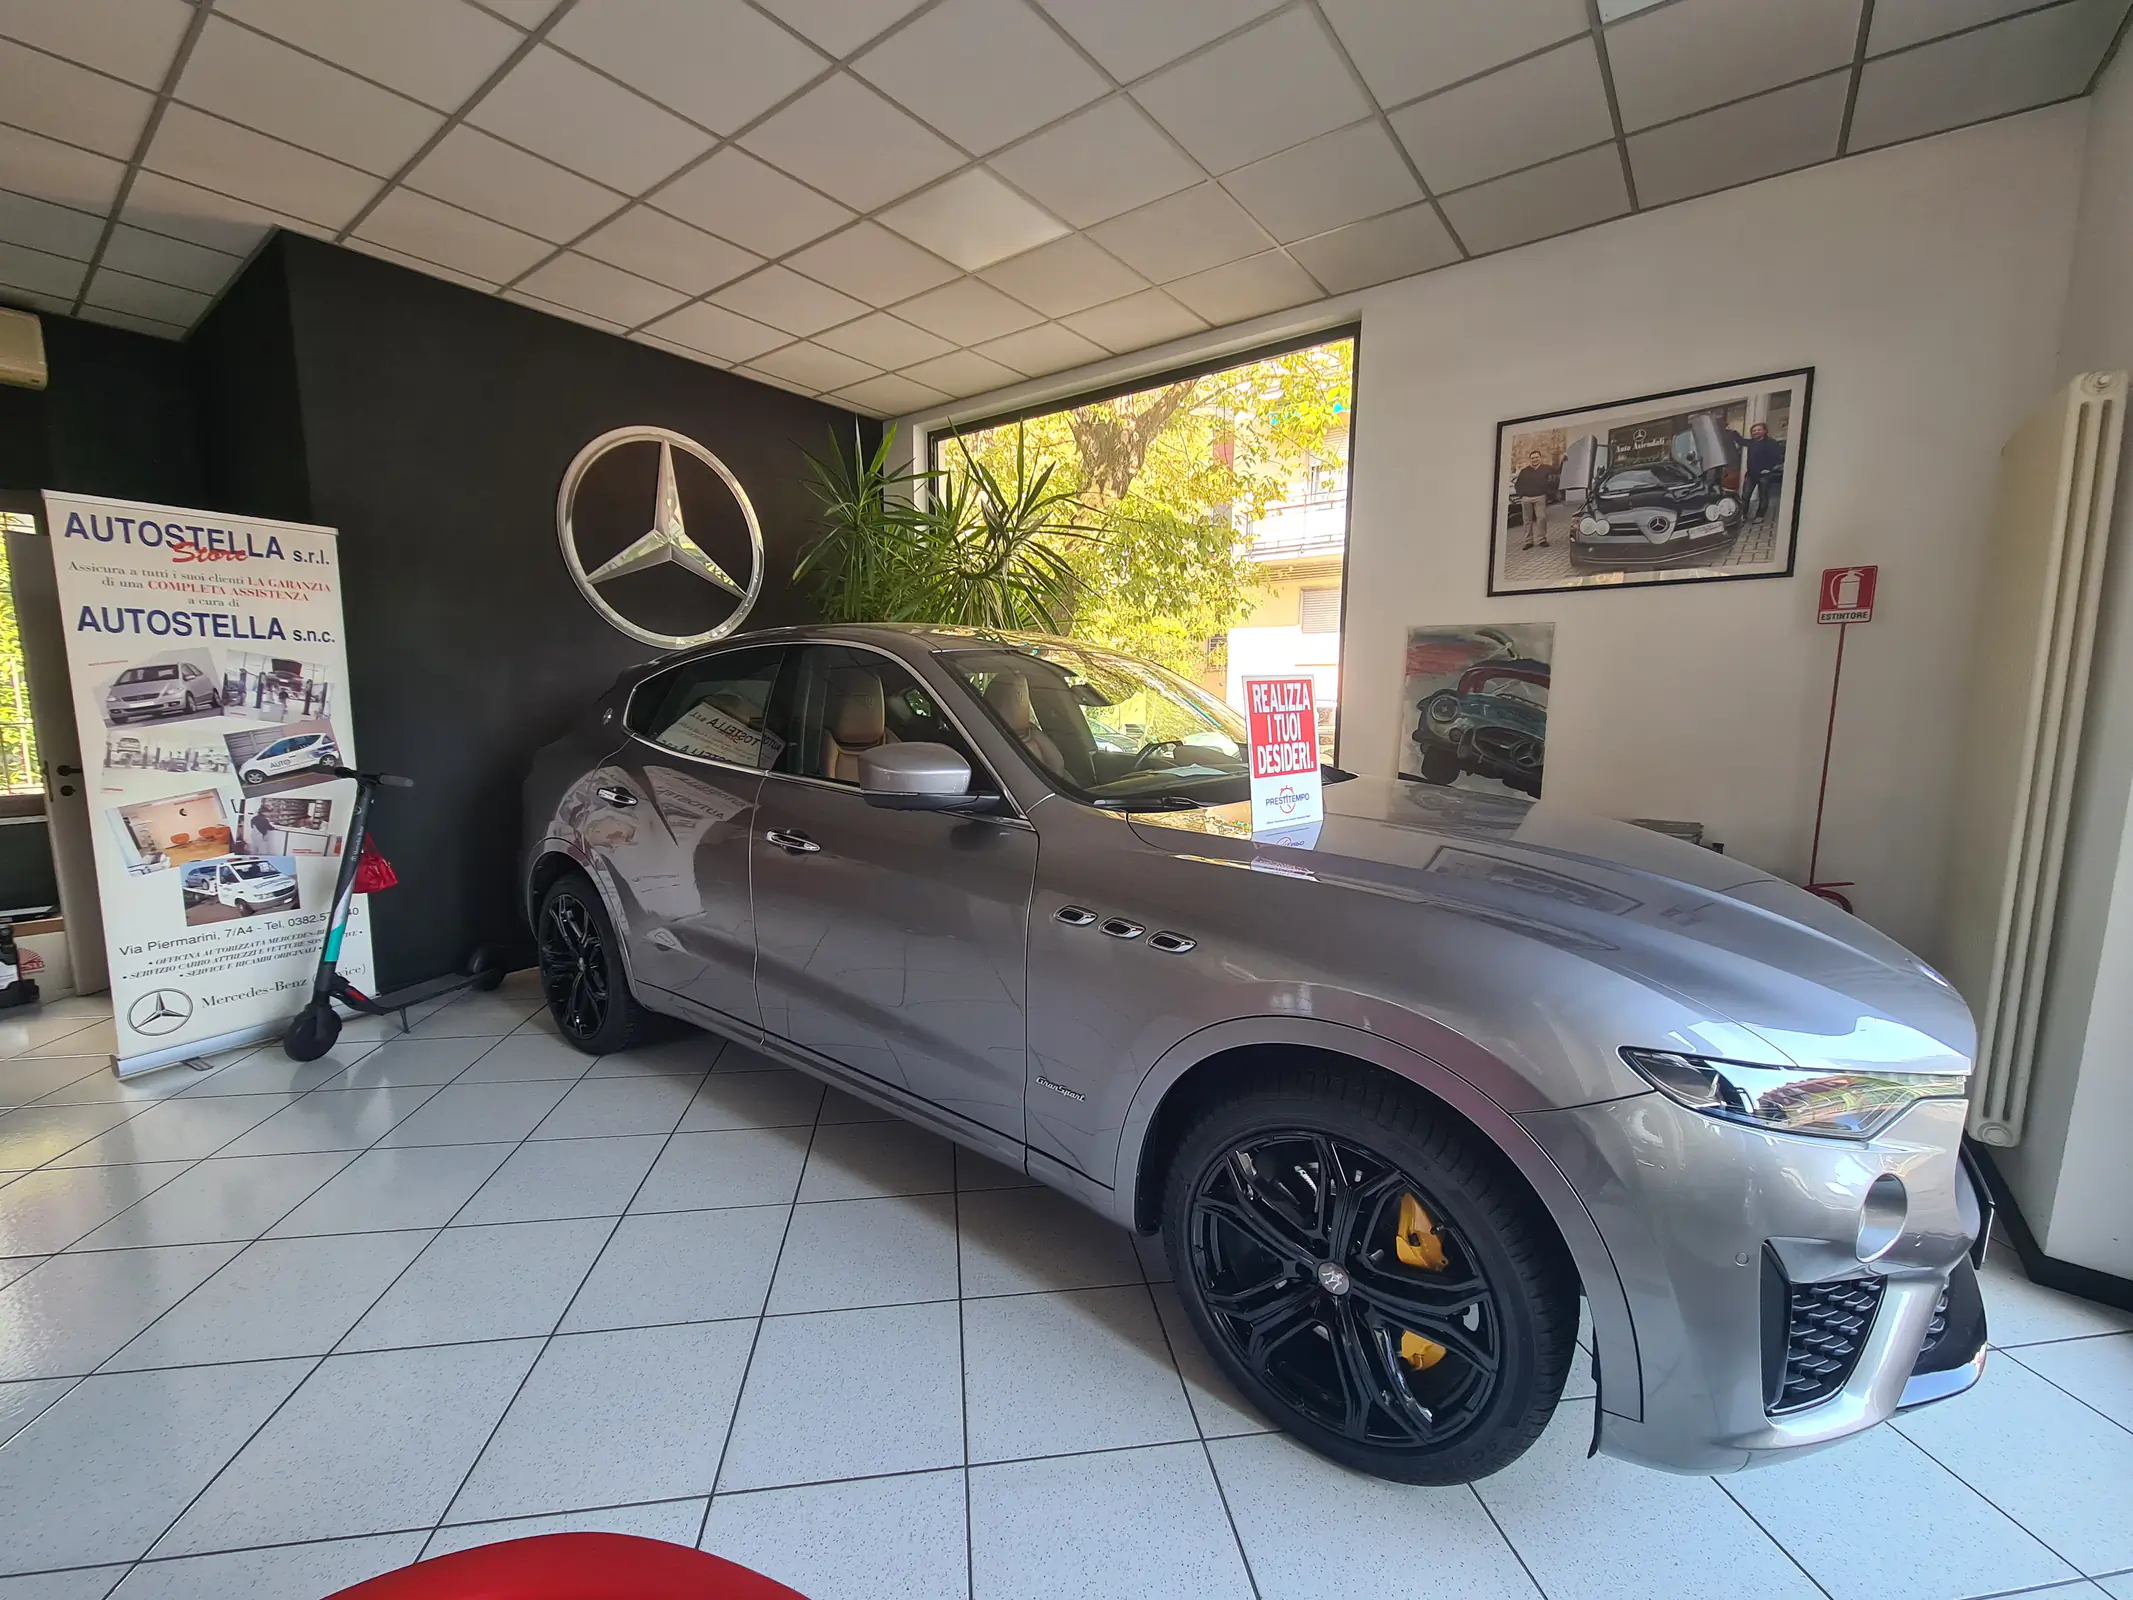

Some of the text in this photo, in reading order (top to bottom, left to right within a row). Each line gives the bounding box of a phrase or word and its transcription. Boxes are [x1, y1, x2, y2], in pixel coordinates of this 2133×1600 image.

[64, 511, 330, 565] AUTOSTELLA s.r.l.
[172, 541, 249, 563] Store
[68, 561, 331, 592] Assicura a tutti i suoi clienti LA GARANZIA
[101, 576, 309, 601] di una COMPLETA ASSISTENZA
[187, 597, 240, 608] a cura di
[77, 606, 335, 643] AUTOSTELLA s.n.c.
[1821, 611, 1868, 621] ESTINTORE
[1252, 683, 1311, 714] REALIZZA
[1267, 712, 1301, 743] I TUOI
[1257, 741, 1314, 775] DESIDERI.
[1265, 793, 1310, 806] PRESTITEMPO
[119, 944, 143, 956] Via
[264, 919, 285, 931] Tel.
[129, 965, 176, 979] SERVIZIO
[178, 958, 211, 971] CARRO
[156, 951, 201, 965] OFFICINA
[185, 964, 225, 977] SERVICE
[235, 955, 272, 968] RICAMBI
[202, 978, 307, 1008] Mercedes-Benz
[1036, 1076, 1085, 1102] GranSport
